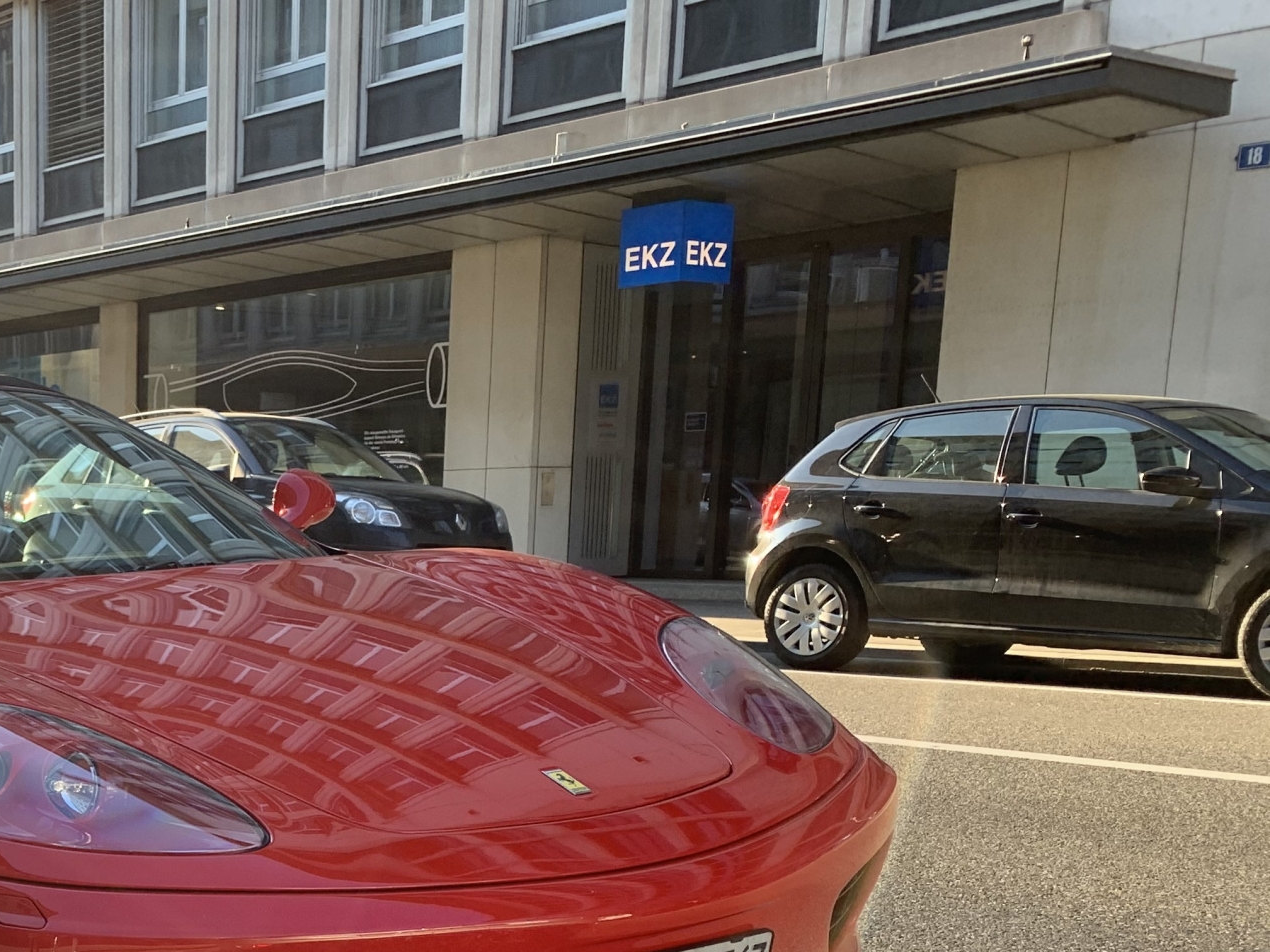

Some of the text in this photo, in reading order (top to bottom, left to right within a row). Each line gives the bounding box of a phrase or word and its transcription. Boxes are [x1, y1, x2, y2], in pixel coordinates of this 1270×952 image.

[1247, 146, 1264, 165] 18
[625, 241, 676, 272] EKZ
[686, 240, 728, 268] EKZ
